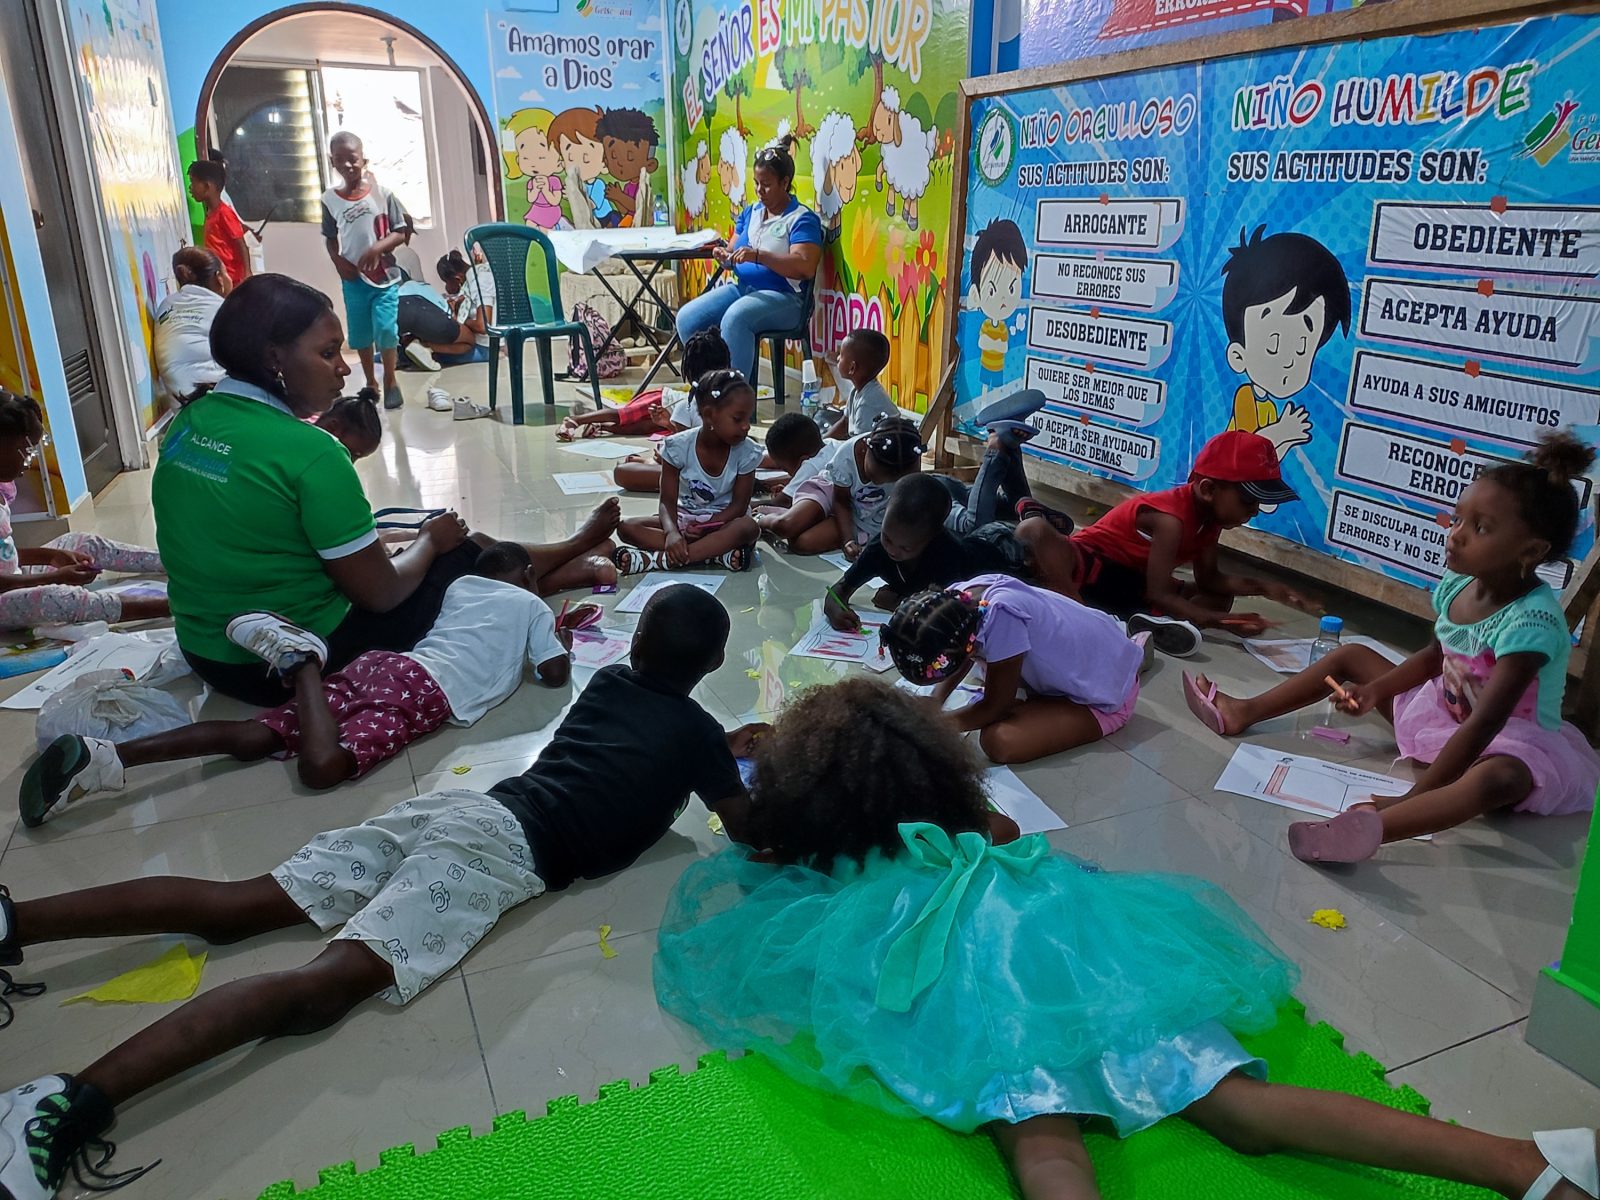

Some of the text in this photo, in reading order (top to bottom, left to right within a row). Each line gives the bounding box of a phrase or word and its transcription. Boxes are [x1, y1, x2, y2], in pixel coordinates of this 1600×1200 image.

[607, 38, 655, 60] orar
[684, 0, 929, 130] EL SEÑOR ES MI PASTOR
[545, 67, 557, 87] a
[1234, 64, 1533, 128] NIÑO HUMILDE
[1020, 95, 1195, 147] NIÑO ORGULLOSO
[1019, 158, 1169, 187] SUS ACTITUDES SON:
[1228, 150, 1488, 182] SUS ACTITUDES SON:
[1064, 214, 1147, 235] ARROGANTE
[1413, 223, 1582, 258] OBEDIENTE
[1058, 263, 1146, 283] NO RECONOCE SUS
[1077, 282, 1121, 299] ERRORES
[1046, 319, 1147, 351] DESOBEDIENTE
[1380, 297, 1556, 342] ACEPTA AYUDA
[1038, 367, 1148, 402] QUIERE SER MEJOR QUE
[1063, 387, 1115, 410] LOS DEMAS
[1363, 374, 1560, 427] AYUDA A SUS AMIGUITOS
[191, 433, 232, 455] ALCANCE
[1032, 416, 1147, 458] NO ACEPTA SER AYUDADO
[1050, 435, 1122, 467] POR LOS DEMAS
[1344, 505, 1359, 518] SE
[1362, 510, 1417, 537] DISCULPA
[1339, 522, 1390, 548] ERRORES
[1393, 539, 1401, 551] Y
[1404, 543, 1420, 558] NO
[1424, 550, 1440, 565] SE
